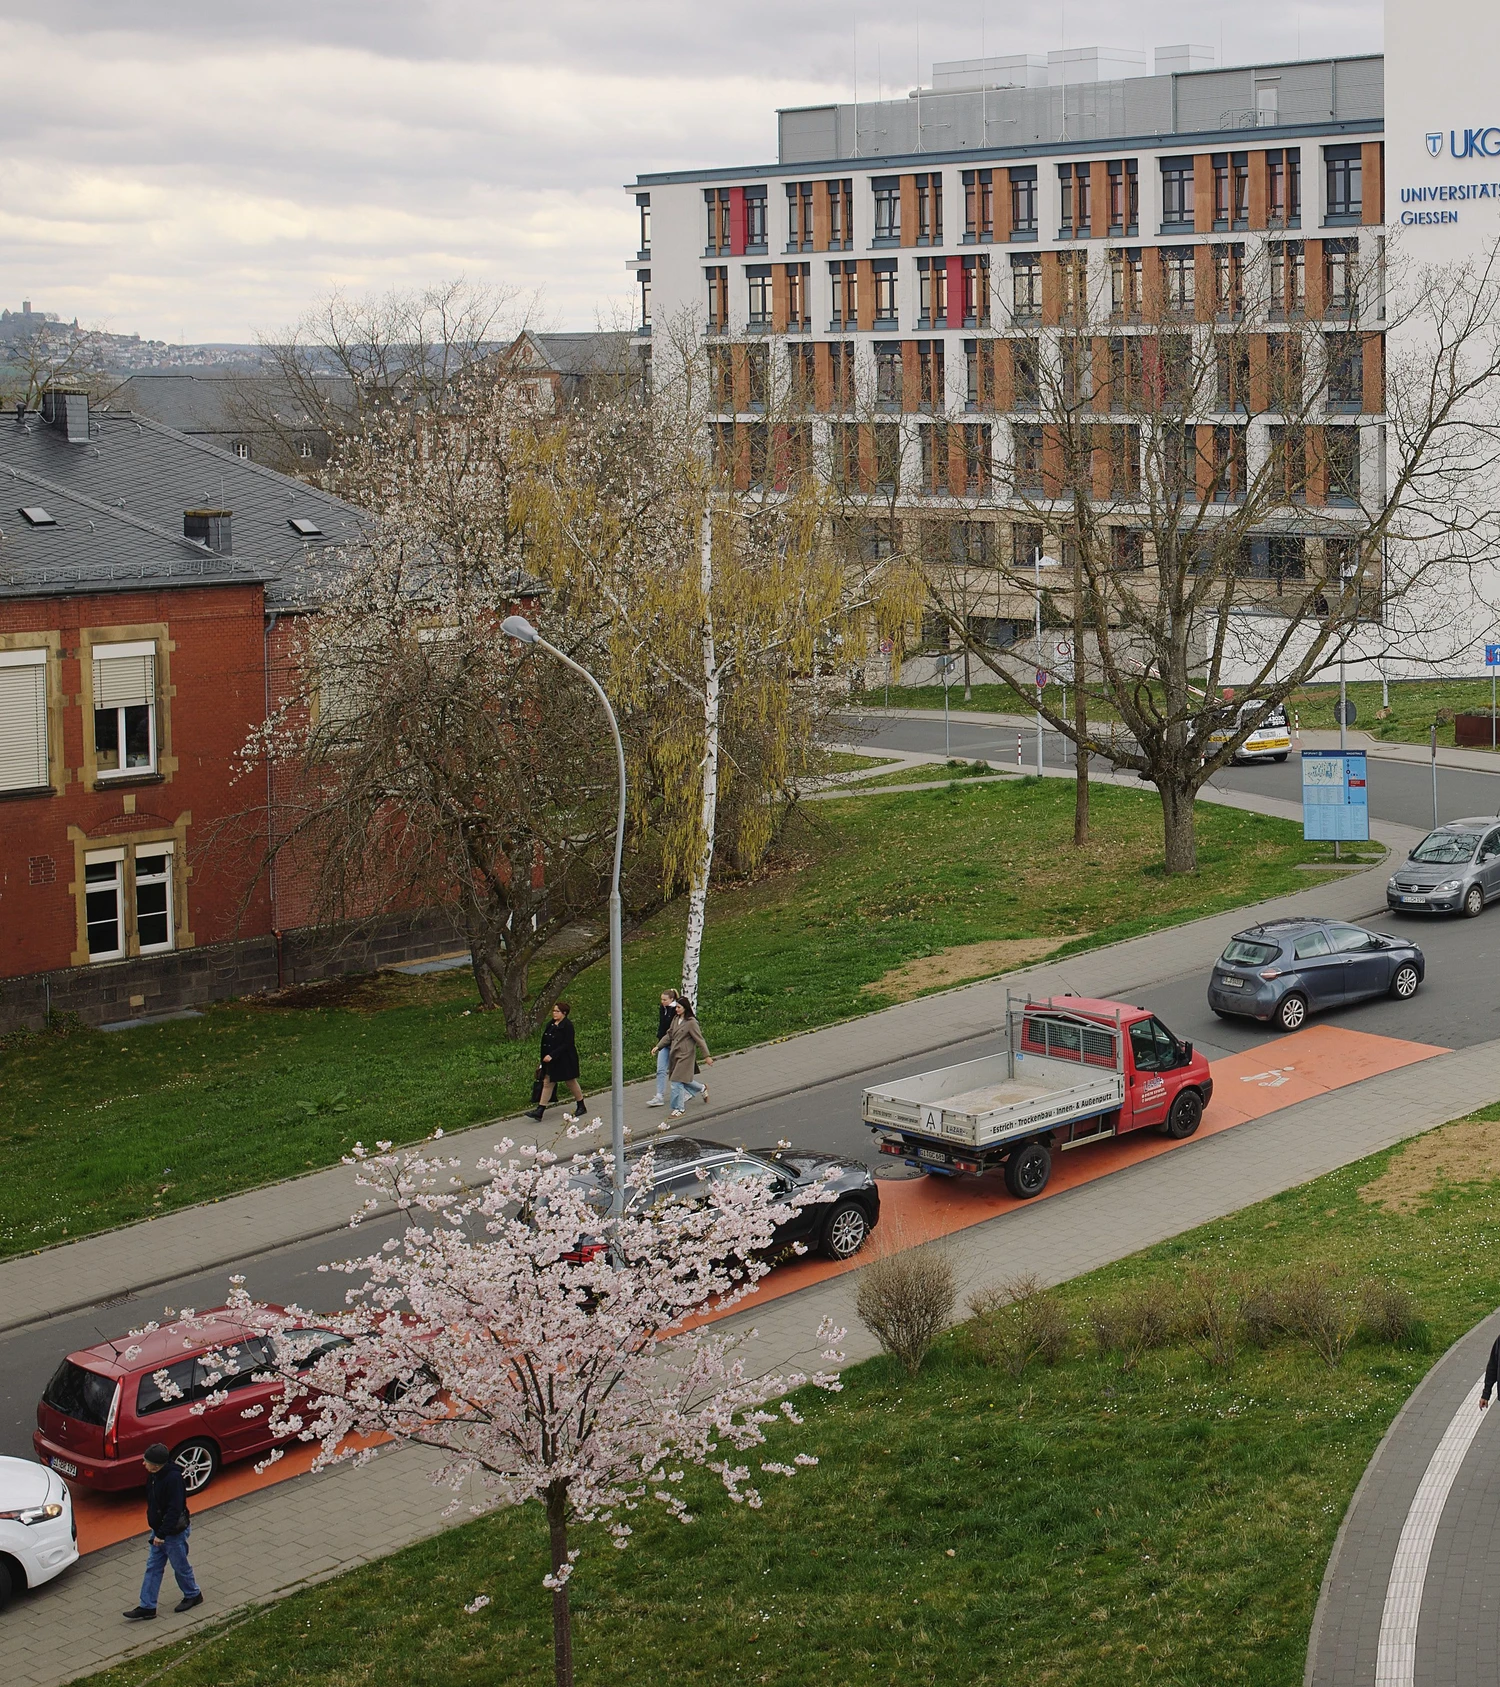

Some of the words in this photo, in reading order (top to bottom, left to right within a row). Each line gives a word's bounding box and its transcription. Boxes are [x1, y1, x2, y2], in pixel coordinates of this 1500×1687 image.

[925, 1111, 936, 1130] A
[992, 1121, 1014, 1135] Estrich
[1017, 1110, 1053, 1126] Trockenbau
[1056, 1104, 1075, 1115] Innen-
[1081, 1093, 1112, 1108] Außenputz
